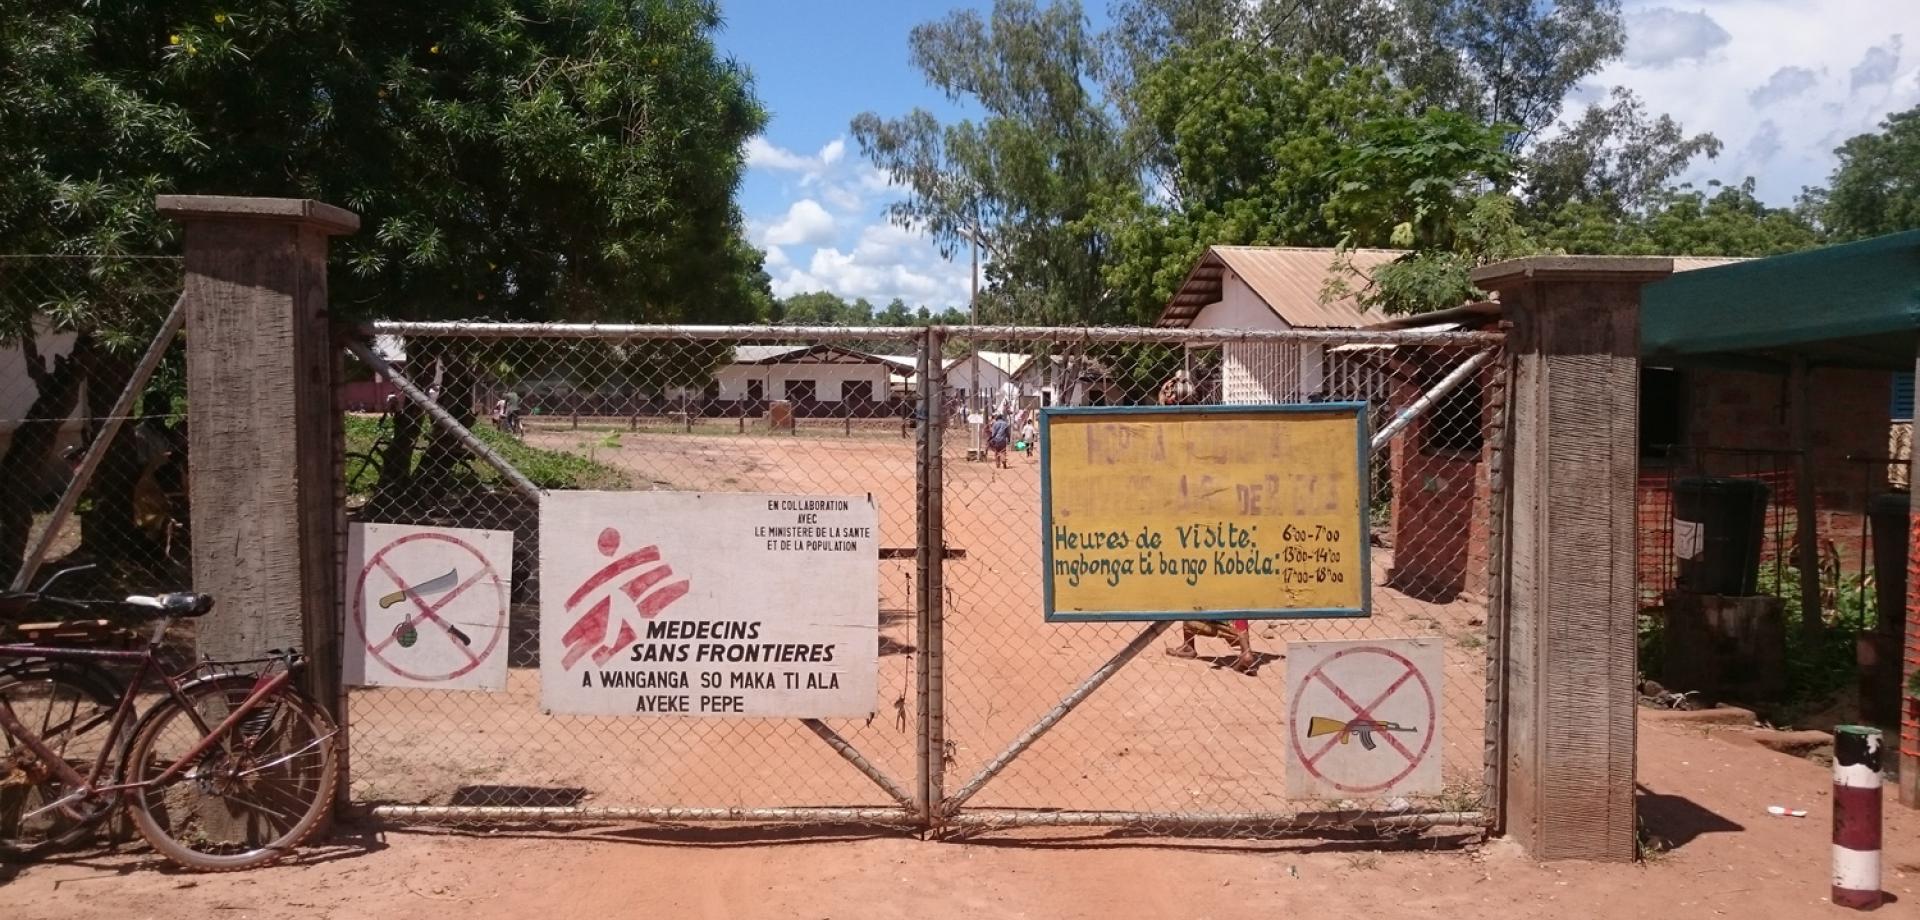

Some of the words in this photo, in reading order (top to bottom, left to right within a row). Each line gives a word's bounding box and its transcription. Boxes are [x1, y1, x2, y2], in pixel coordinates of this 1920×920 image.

[768, 500, 779, 511] EN
[781, 500, 849, 511] COLLABORATION
[797, 513, 818, 524] AVEC
[754, 526, 766, 537] LE
[768, 527, 814, 538] MINISTERE
[816, 527, 827, 538] DE
[829, 527, 841, 538] LA
[843, 527, 871, 538] SANTE
[1055, 526, 1130, 550] Heures
[1136, 526, 1162, 549] de
[767, 540, 778, 551] ET
[780, 540, 792, 551] DE
[794, 540, 804, 551] LA
[806, 541, 857, 552] POPULATION
[1055, 553, 1134, 587] mgbonga
[1139, 552, 1154, 575] ti
[646, 621, 761, 640] MEDECINS
[630, 644, 689, 662] SANS
[695, 644, 836, 663] FRONTIERES
[582, 671, 592, 688] A
[599, 671, 690, 689] WANGANGA
[700, 671, 723, 689] SO
[730, 672, 776, 690] MAKA
[783, 672, 800, 690] TI
[806, 672, 840, 690] ALA
[635, 695, 690, 712] AYEKE
[700, 696, 745, 713] PEPE
